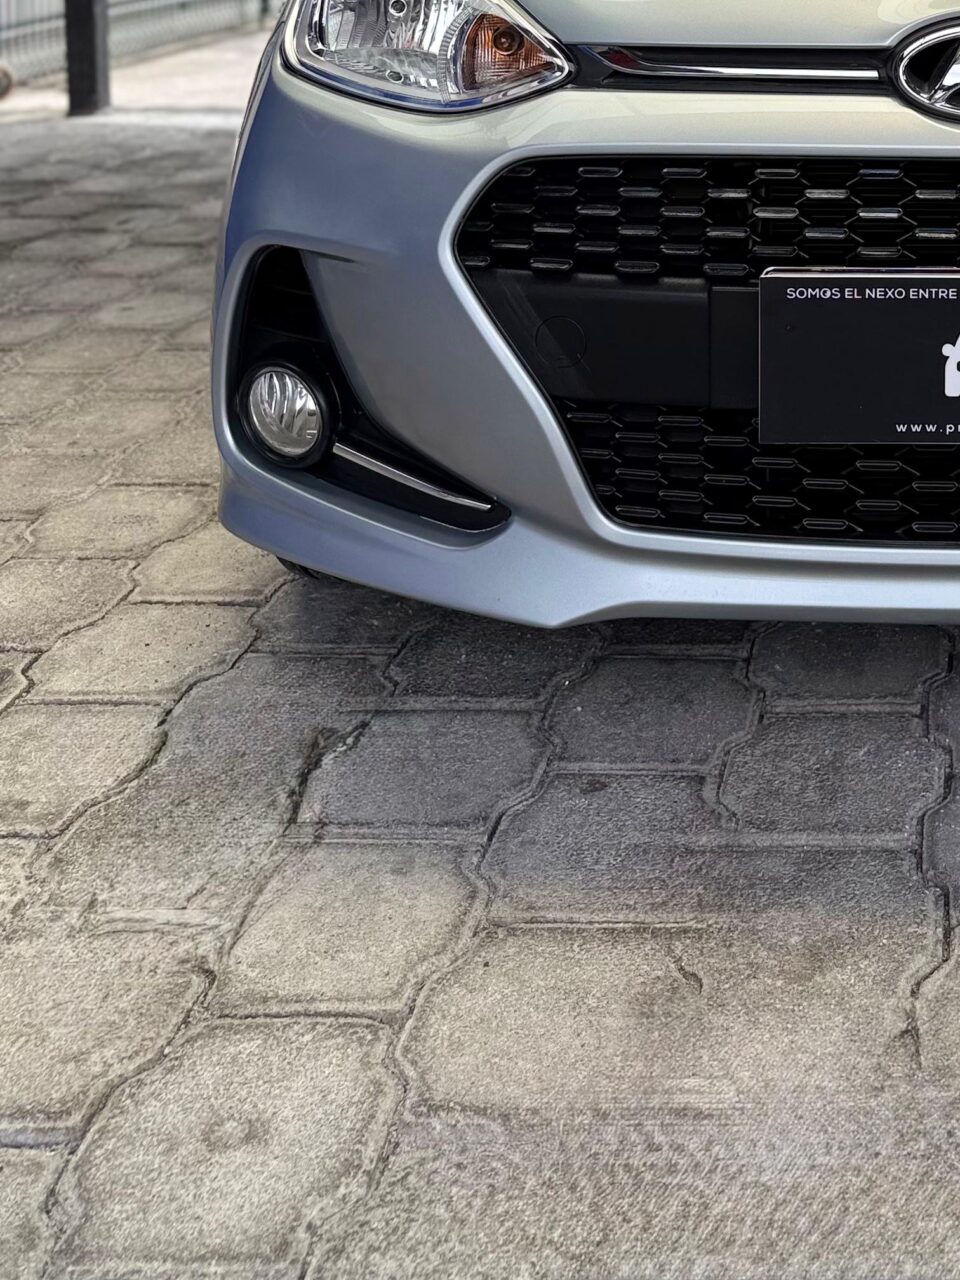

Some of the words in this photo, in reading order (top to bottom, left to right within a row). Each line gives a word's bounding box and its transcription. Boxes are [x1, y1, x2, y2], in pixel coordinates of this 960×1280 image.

[786, 287, 841, 299] SOMOS
[844, 288, 862, 299] EL
[865, 288, 906, 299] NEXO
[909, 288, 957, 300] ENTRE
